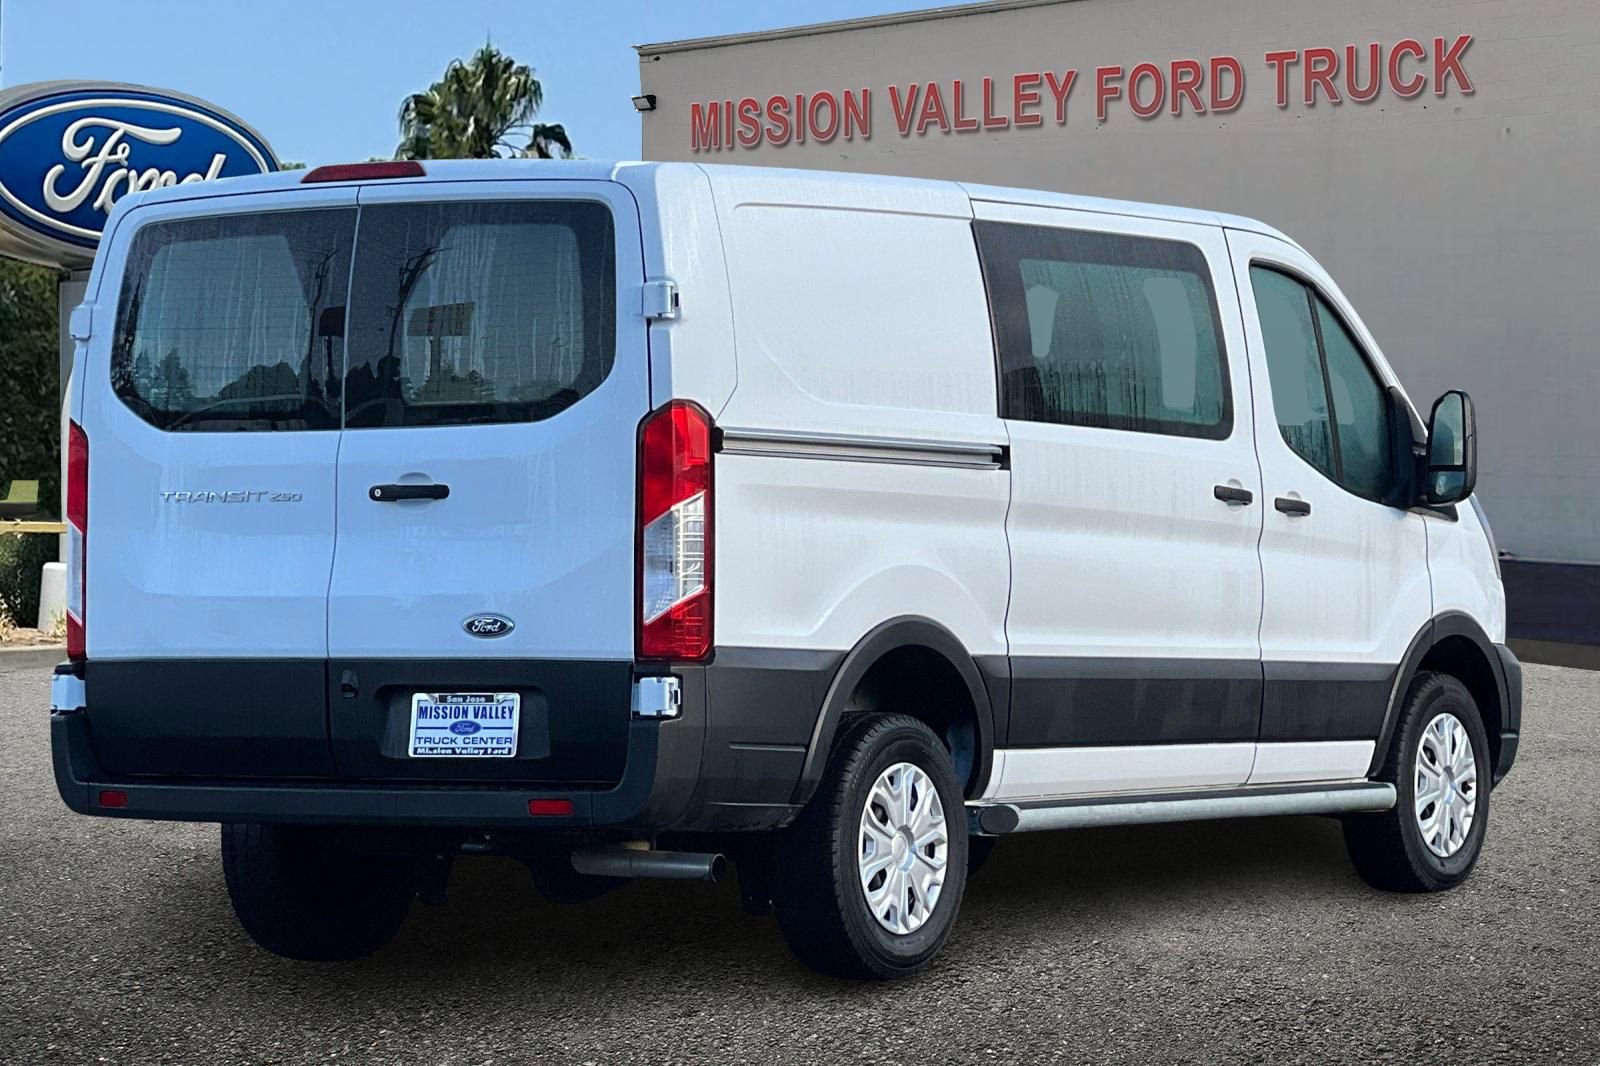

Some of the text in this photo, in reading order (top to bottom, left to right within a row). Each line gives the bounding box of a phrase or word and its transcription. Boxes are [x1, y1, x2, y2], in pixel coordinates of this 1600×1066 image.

[690, 34, 1475, 150] MISSION VALLEY FORD TRUCK
[160, 490, 303, 504] TRANSIT 250
[471, 618, 501, 632] Ford
[446, 695, 486, 703] San Jose
[418, 705, 514, 720] MISSION VALLEY
[454, 721, 475, 733] Ford
[416, 736, 512, 745] TRUCK CENTER
[454, 747, 484, 755] Valley
